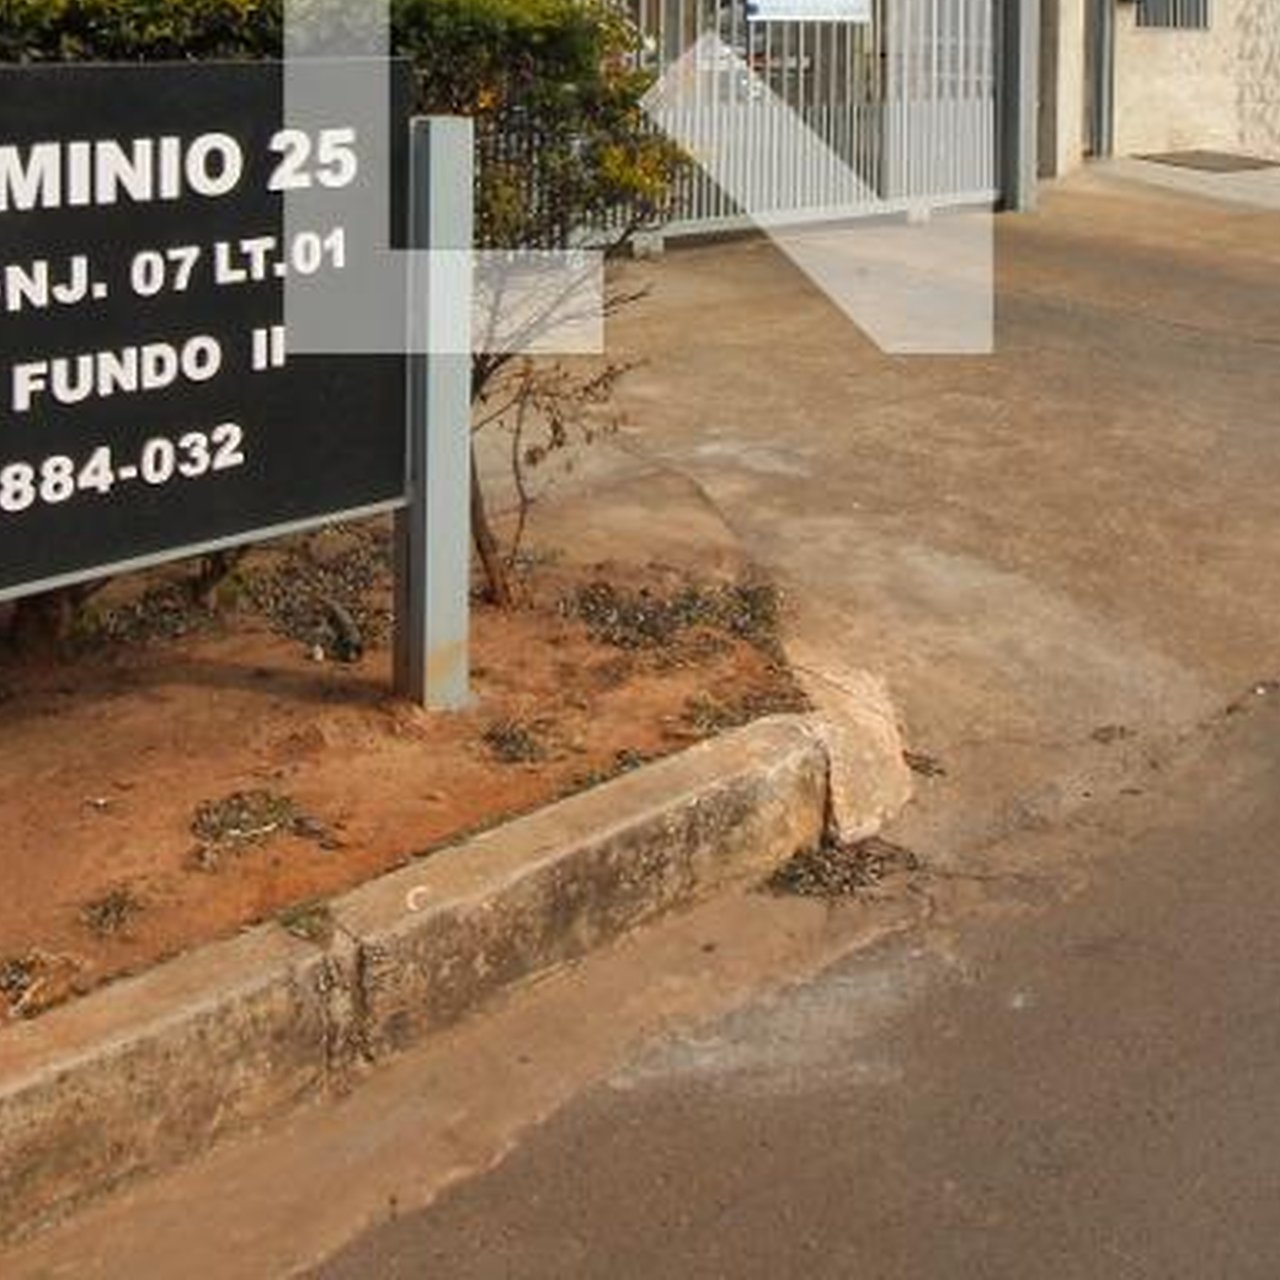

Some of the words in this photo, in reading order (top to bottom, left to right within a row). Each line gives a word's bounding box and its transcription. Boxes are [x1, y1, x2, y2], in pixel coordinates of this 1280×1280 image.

[266, 126, 360, 192] 25
[130, 245, 201, 296] 07
[11, 335, 222, 412] FUNDO
[251, 325, 287, 371] II
